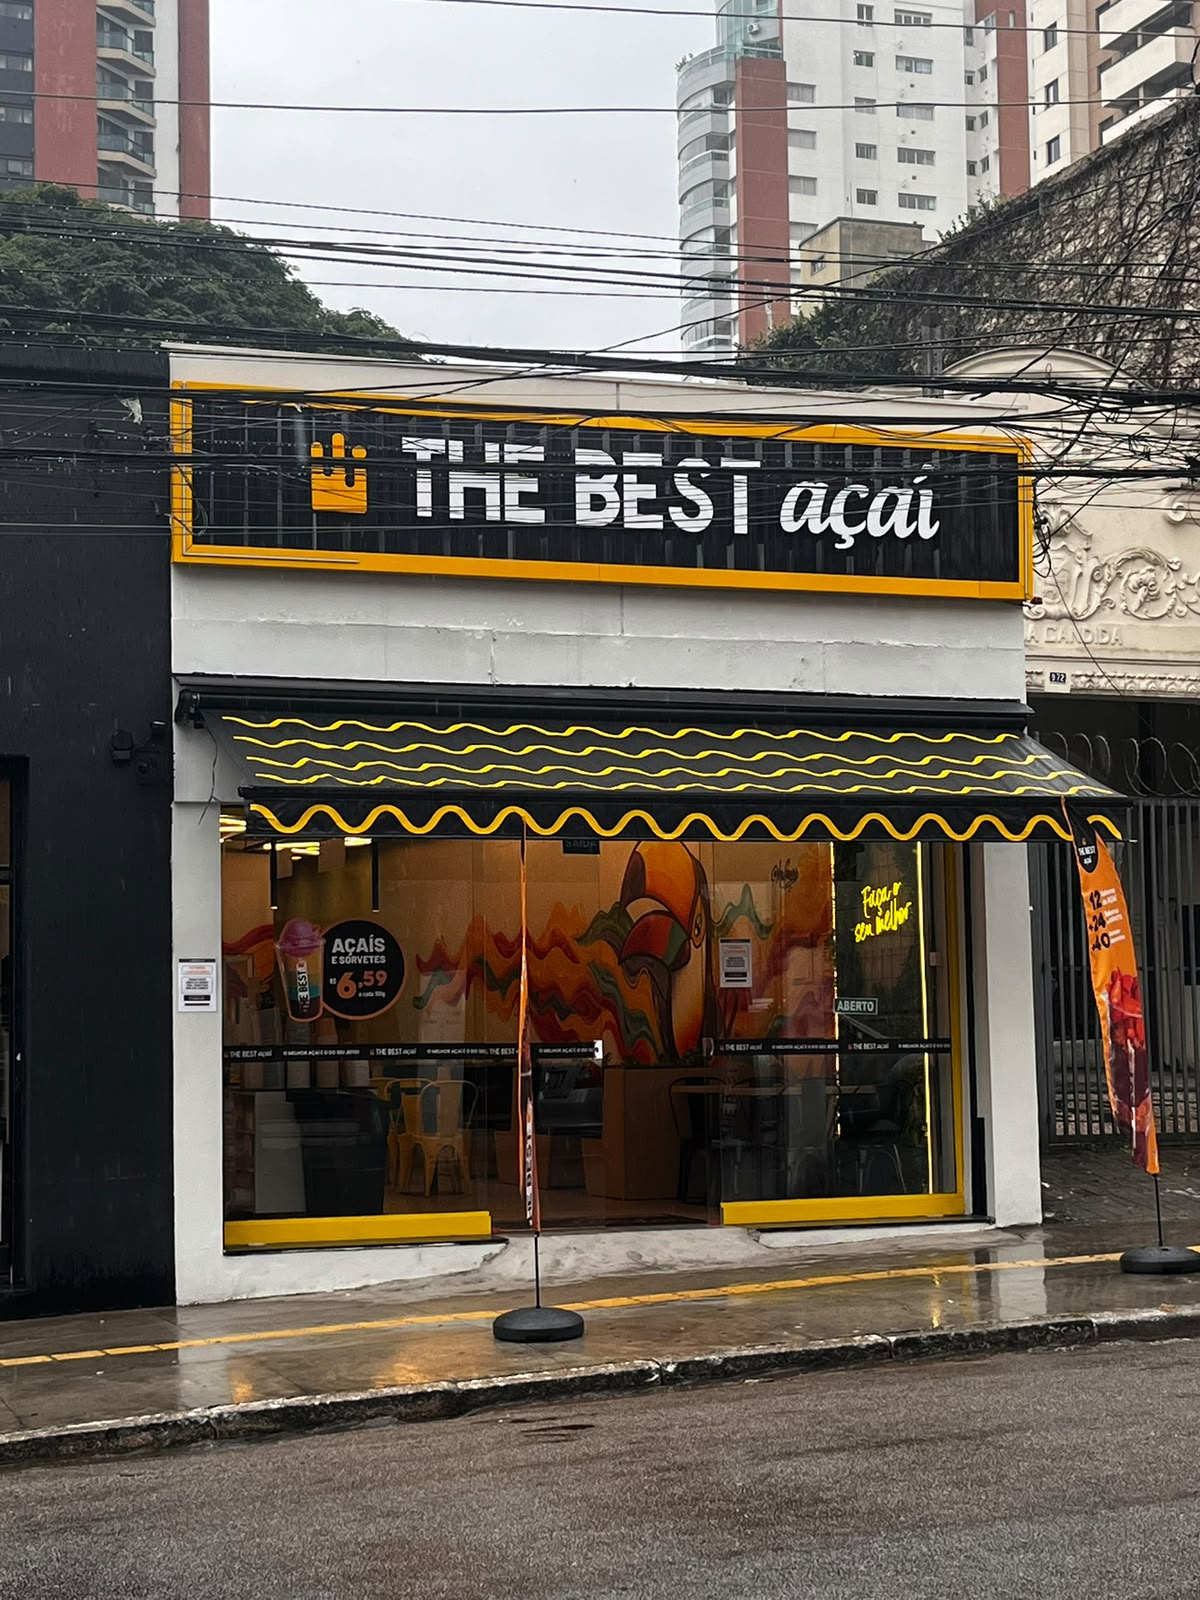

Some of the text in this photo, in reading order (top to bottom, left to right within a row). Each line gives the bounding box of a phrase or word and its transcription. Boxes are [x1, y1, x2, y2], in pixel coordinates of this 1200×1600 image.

[402, 437, 940, 549] THE BEST açaí
[332, 934, 386, 956] AÇAÍS
[331, 955, 386, 964] E SORVETES
[297, 970, 309, 994] BEST
[337, 970, 388, 999] 6,59
[837, 1000, 874, 1012] ABERTO
[387, 1048, 402, 1056] BEST
[736, 1043, 750, 1051] BEST
